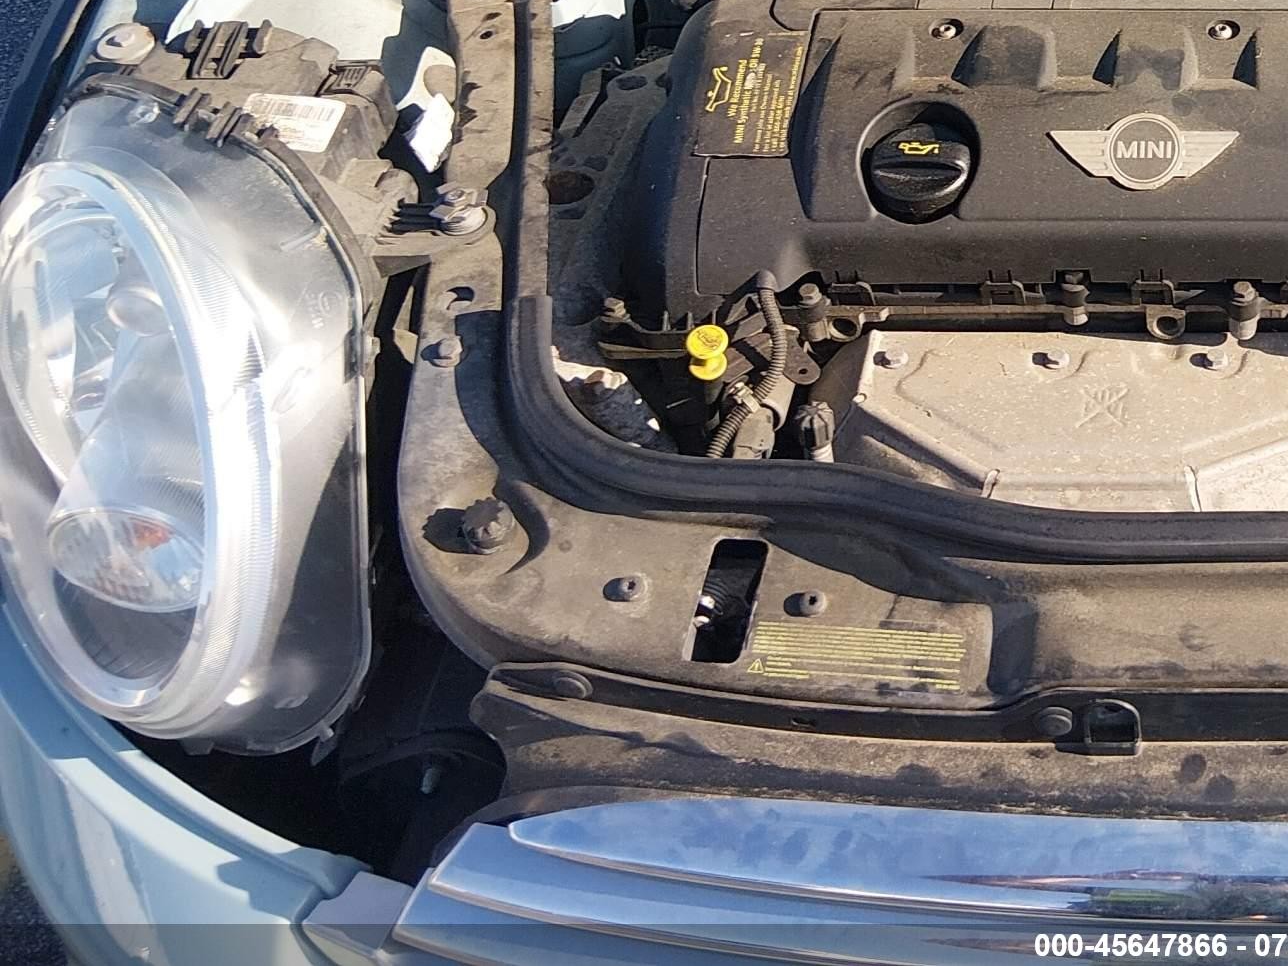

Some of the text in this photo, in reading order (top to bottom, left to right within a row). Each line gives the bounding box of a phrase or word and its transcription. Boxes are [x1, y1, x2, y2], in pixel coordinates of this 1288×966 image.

[727, 59, 747, 116] We Recommend
[737, 91, 752, 123] Synthetic
[734, 124, 745, 143] MINI
[1116, 140, 1173, 159] MINI
